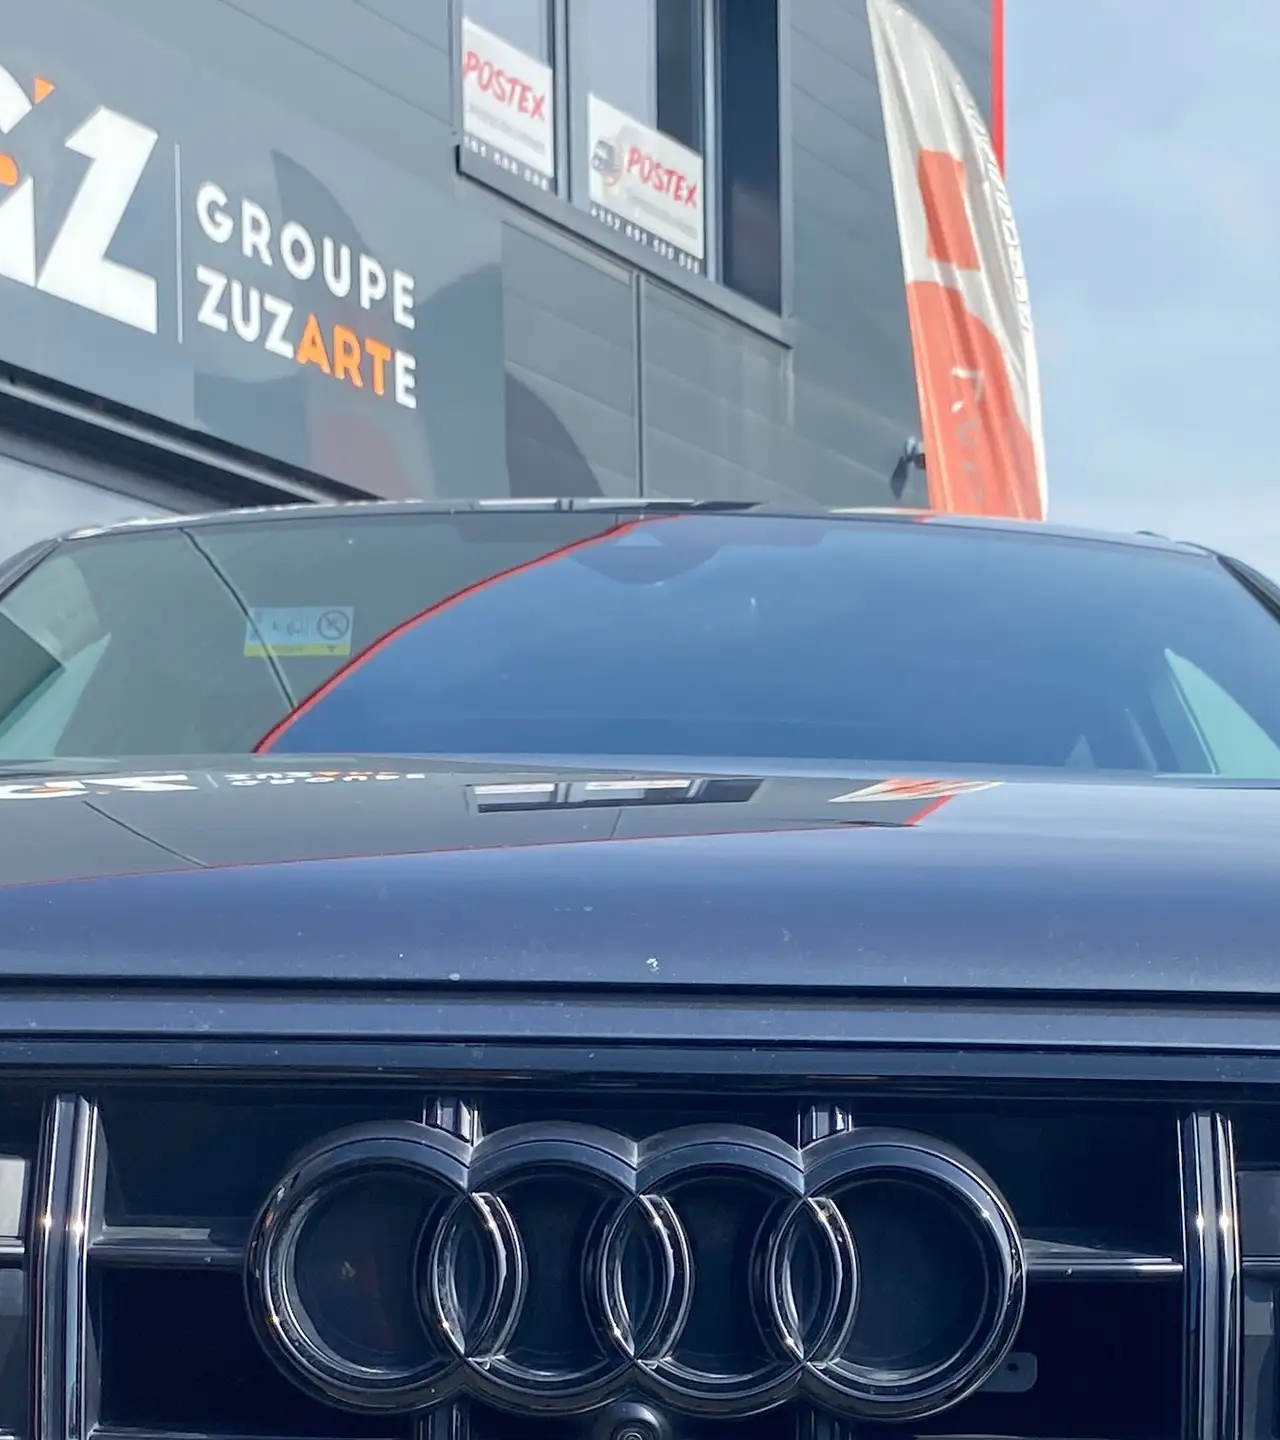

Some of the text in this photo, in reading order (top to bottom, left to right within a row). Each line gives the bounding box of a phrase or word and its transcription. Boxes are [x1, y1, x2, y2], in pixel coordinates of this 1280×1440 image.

[462, 50, 546, 122] POSTEX
[627, 145, 699, 209] POSTEX
[196, 182, 416, 329] GROUPE
[196, 264, 417, 409] ZUZARTE
